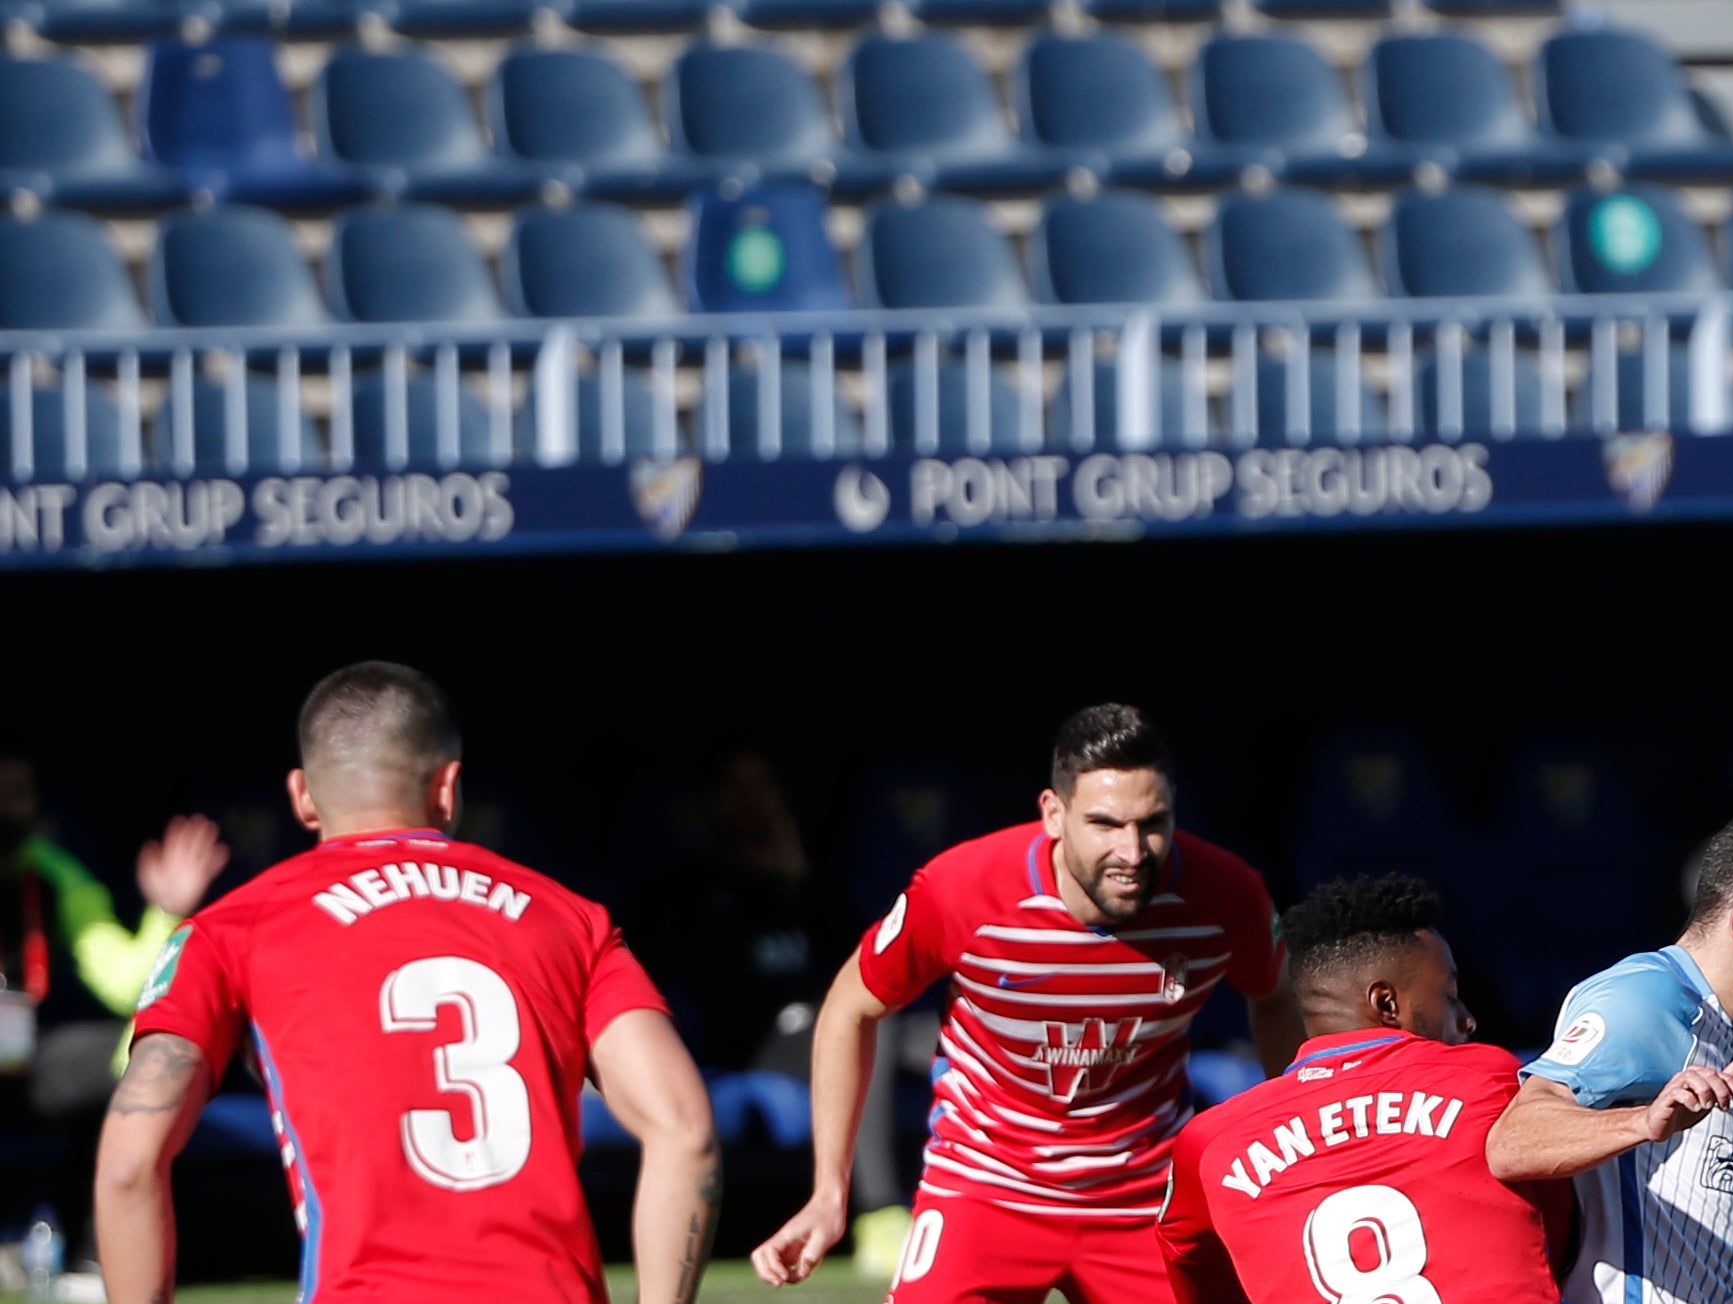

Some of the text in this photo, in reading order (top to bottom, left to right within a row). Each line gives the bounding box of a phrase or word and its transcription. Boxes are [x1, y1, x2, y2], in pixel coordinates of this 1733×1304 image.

[82, 480, 244, 552] GRUP
[252, 472, 514, 547] SEGUROS
[911, 443, 1493, 527] PONT GRUP SEGUROS
[312, 862, 531, 925] NEHUEN
[379, 956, 533, 1191] 3
[1046, 1046, 1127, 1067] WINAMAX
[1222, 1092, 1463, 1198] YAN ETEKI
